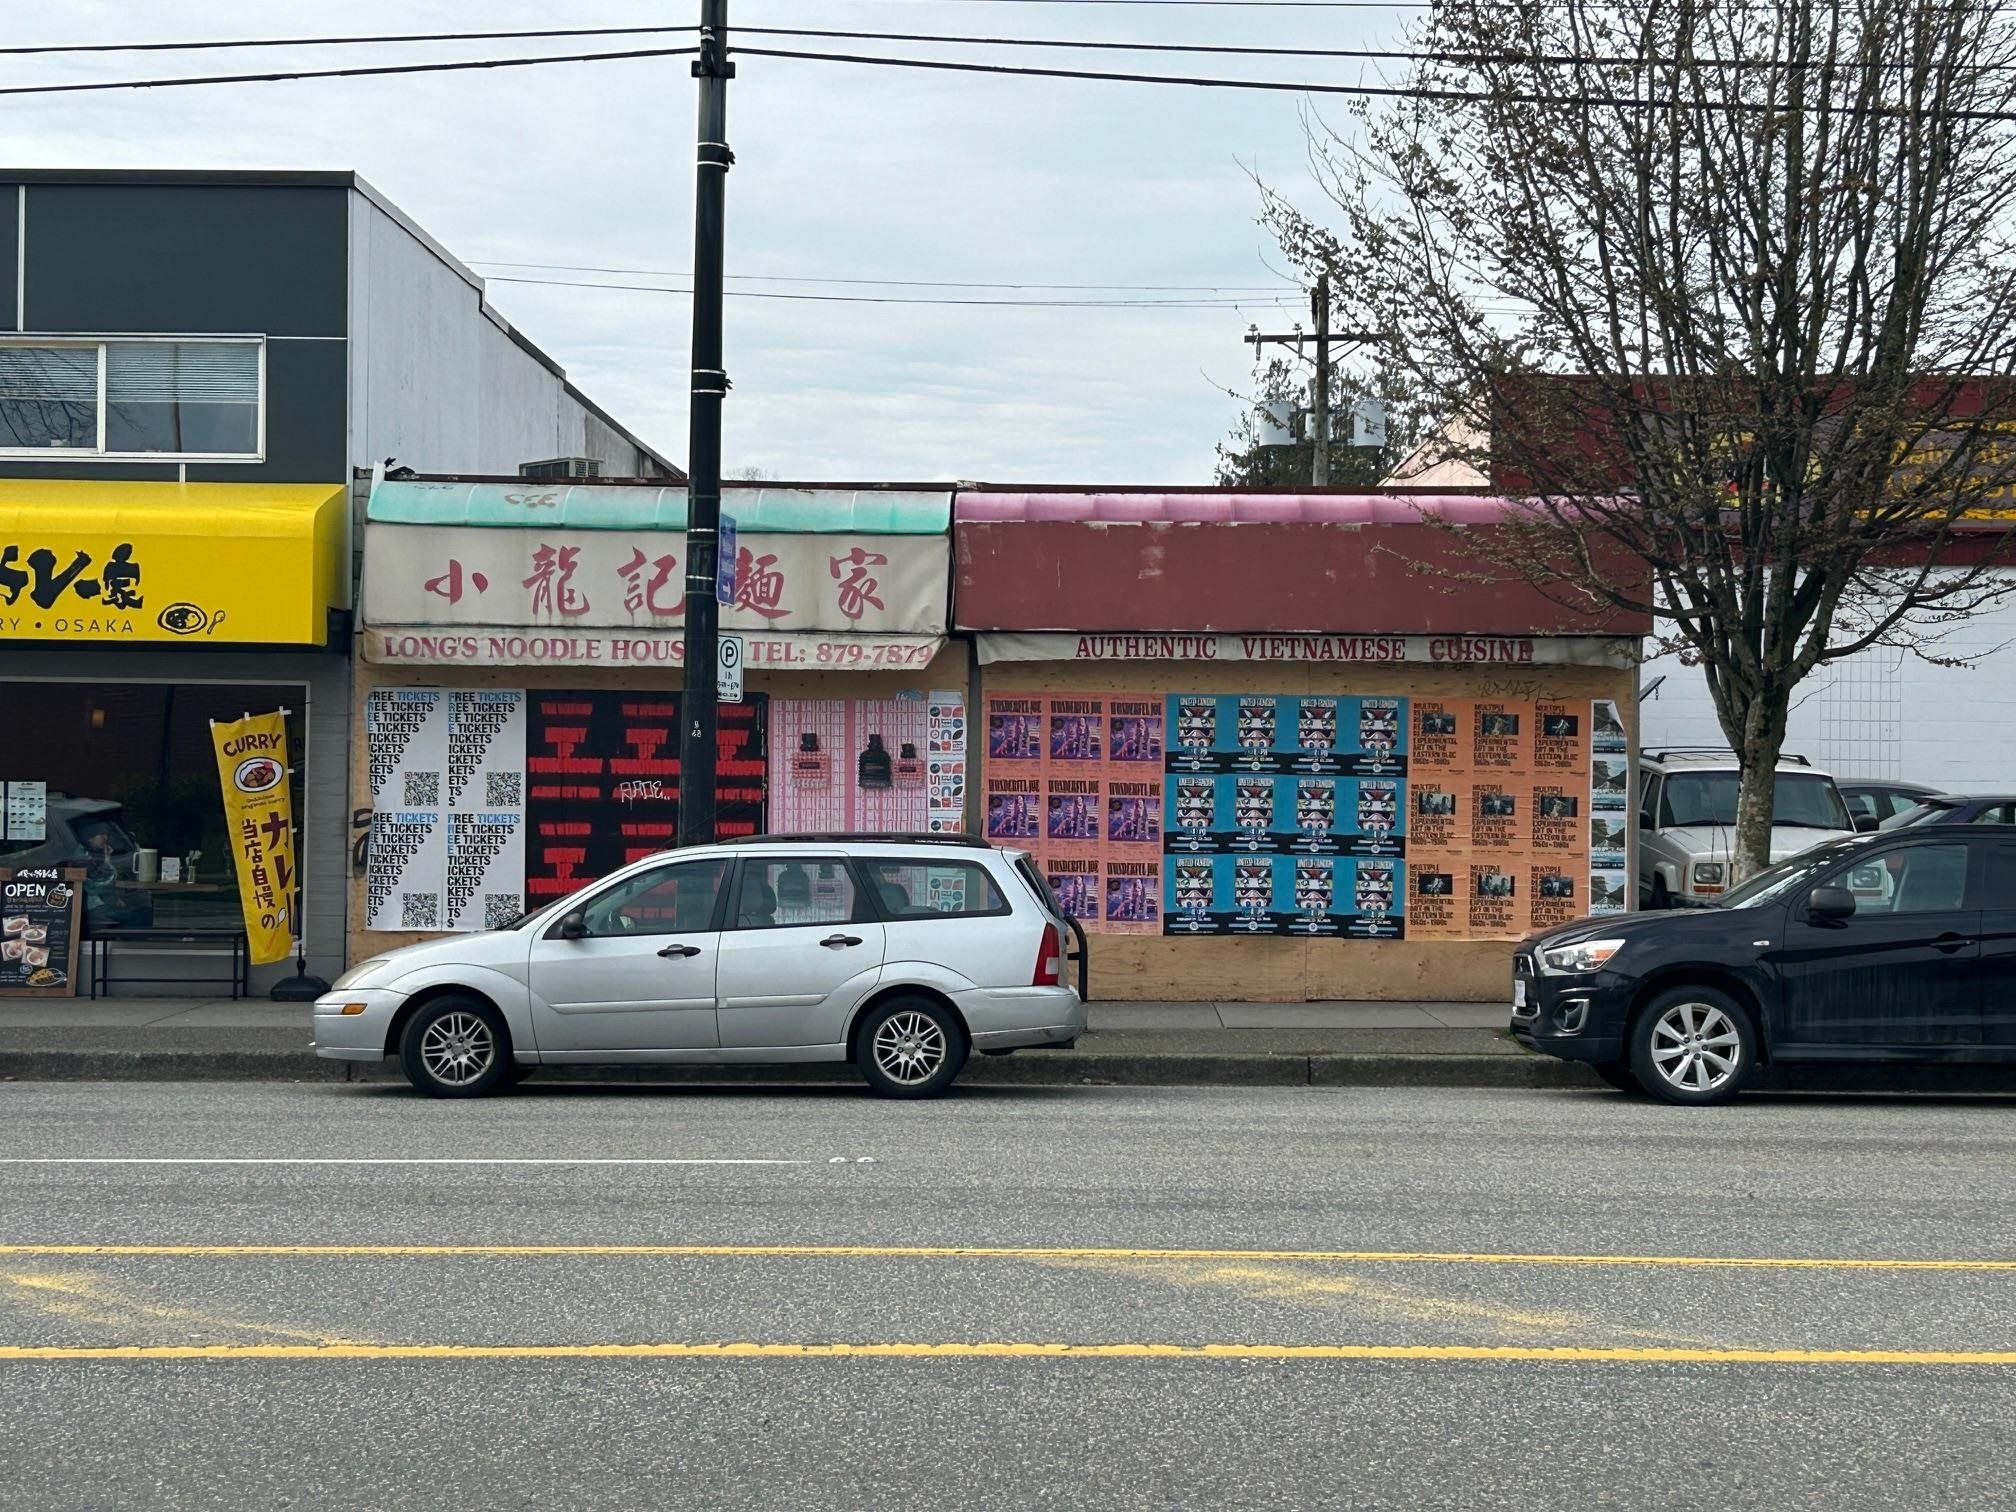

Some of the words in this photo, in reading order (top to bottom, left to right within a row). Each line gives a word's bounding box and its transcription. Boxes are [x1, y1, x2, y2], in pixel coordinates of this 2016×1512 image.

[56, 620, 133, 632] OSAKA
[384, 636, 478, 658] LONG'S
[488, 637, 600, 661] NOODLE
[611, 638, 686, 661] HOUS
[750, 642, 806, 662] TEL:
[816, 642, 933, 664] 879-7879
[1076, 636, 1216, 658] AUTHENTIC
[1240, 637, 1406, 661] VIETNAMESE
[1429, 638, 1534, 662] CUISINE
[398, 692, 440, 701] TICKETS
[448, 692, 475, 702] FREE
[479, 692, 521, 702] TICKETS
[391, 702, 434, 712] TICKETS
[472, 703, 515, 712] TICKETS
[384, 712, 426, 722] TICKETS
[464, 713, 507, 722] TICKETS
[376, 723, 419, 732] TICKETS
[458, 724, 500, 733] TICKETS
[369, 734, 410, 743] TICKETS
[449, 734, 492, 744] TICKETS
[223, 733, 282, 756] CURRY
[449, 744, 486, 754] ICKETS
[449, 755, 482, 764] CKETS
[449, 765, 475, 775] KETS
[449, 776, 468, 785] ETS
[450, 786, 462, 796] TS
[372, 813, 392, 822] REE
[396, 812, 438, 823] TICKETS
[448, 814, 474, 823] FREE
[478, 814, 520, 824] TICKETS
[390, 824, 432, 833] TICKETS
[471, 825, 514, 834] TICKETS
[381, 834, 424, 844] TICKETS
[463, 835, 506, 844] TICKETS
[376, 844, 418, 854] TICKETS
[456, 845, 500, 855] TICKETS
[370, 854, 408, 864] TICKETS
[448, 856, 490, 865] TICKETS
[242, 818, 276, 929] 当店自慢の
[448, 866, 484, 876] ICKETS
[369, 876, 398, 885] CKETS
[448, 876, 480, 886] CKETS
[5, 884, 46, 897] OPEN
[369, 886, 392, 895] KETS
[448, 887, 474, 896] KETS
[368, 896, 384, 906] ETS
[448, 898, 466, 907] ETS
[449, 908, 460, 918] TS
